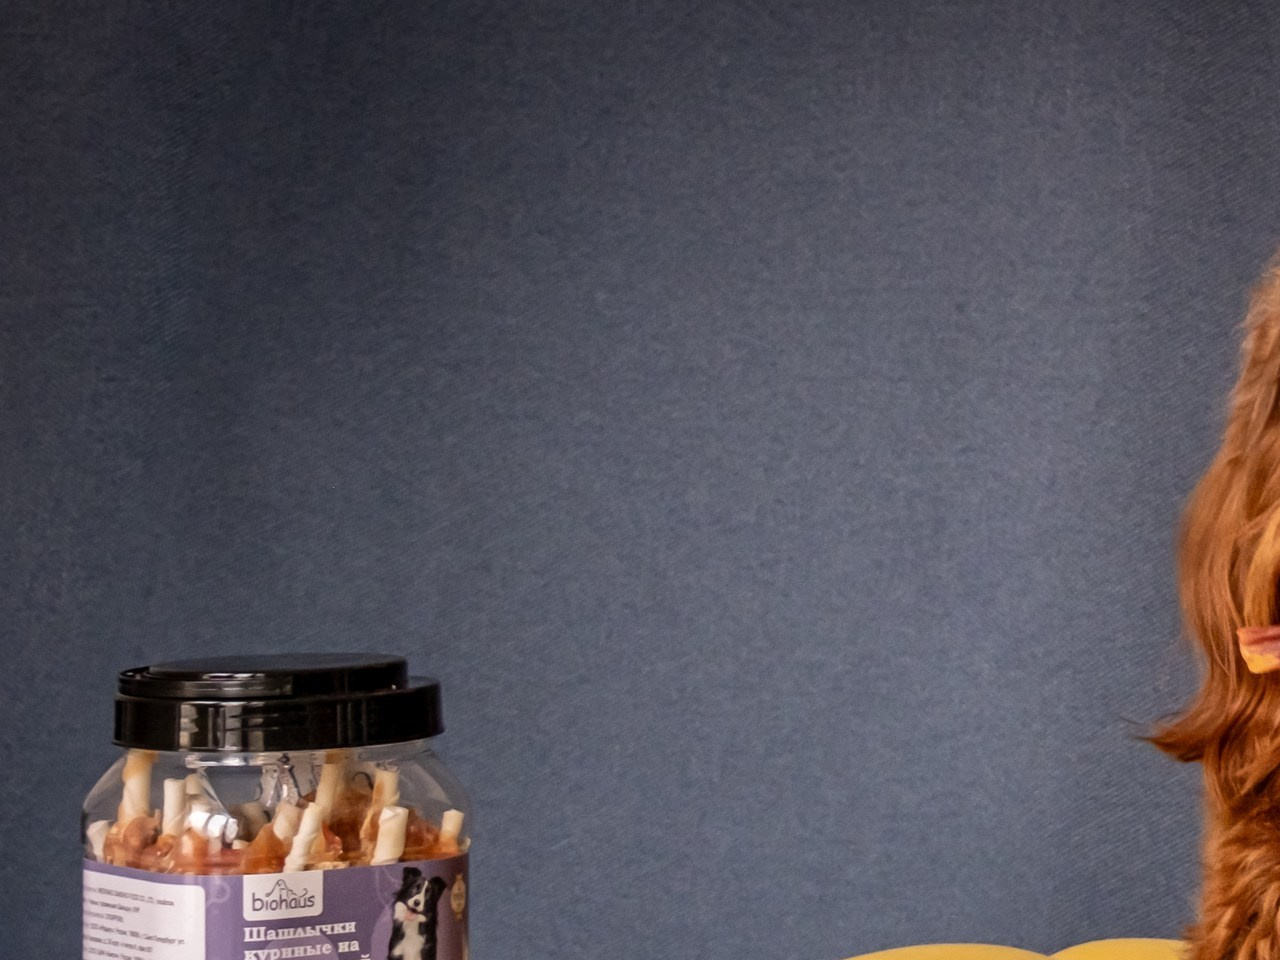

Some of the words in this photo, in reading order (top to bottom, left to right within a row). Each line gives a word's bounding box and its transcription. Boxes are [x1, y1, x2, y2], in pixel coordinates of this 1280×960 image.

[252, 892, 315, 911] biohaus
[244, 921, 356, 942] Шашлычки
[338, 940, 360, 953] на
